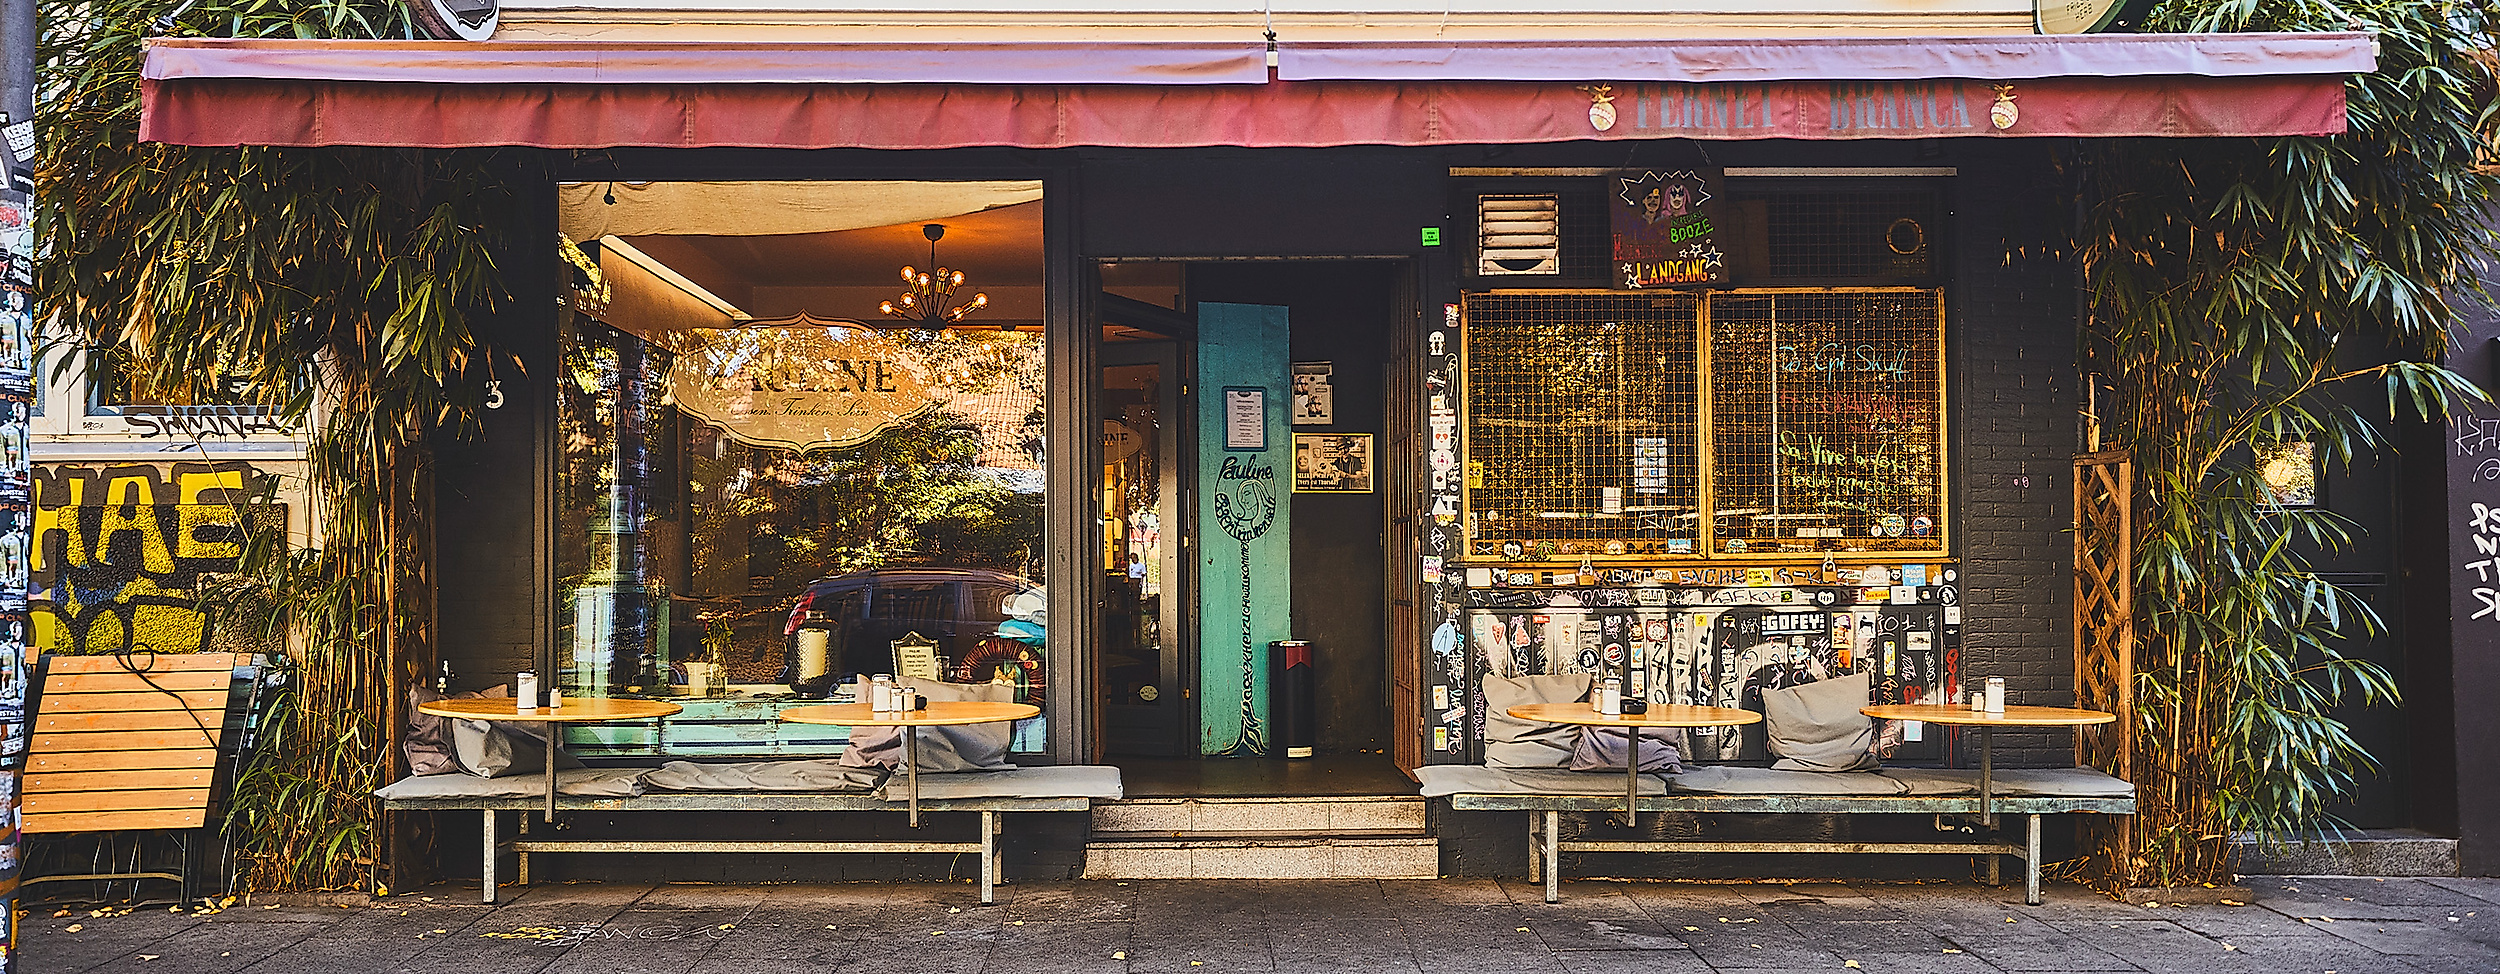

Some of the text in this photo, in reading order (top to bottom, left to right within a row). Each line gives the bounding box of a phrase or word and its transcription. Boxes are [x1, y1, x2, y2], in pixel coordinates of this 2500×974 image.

[1829, 80, 1974, 131] BRANCA
[1670, 218, 1714, 243] BOOZE
[485, 379, 505, 409] 3
